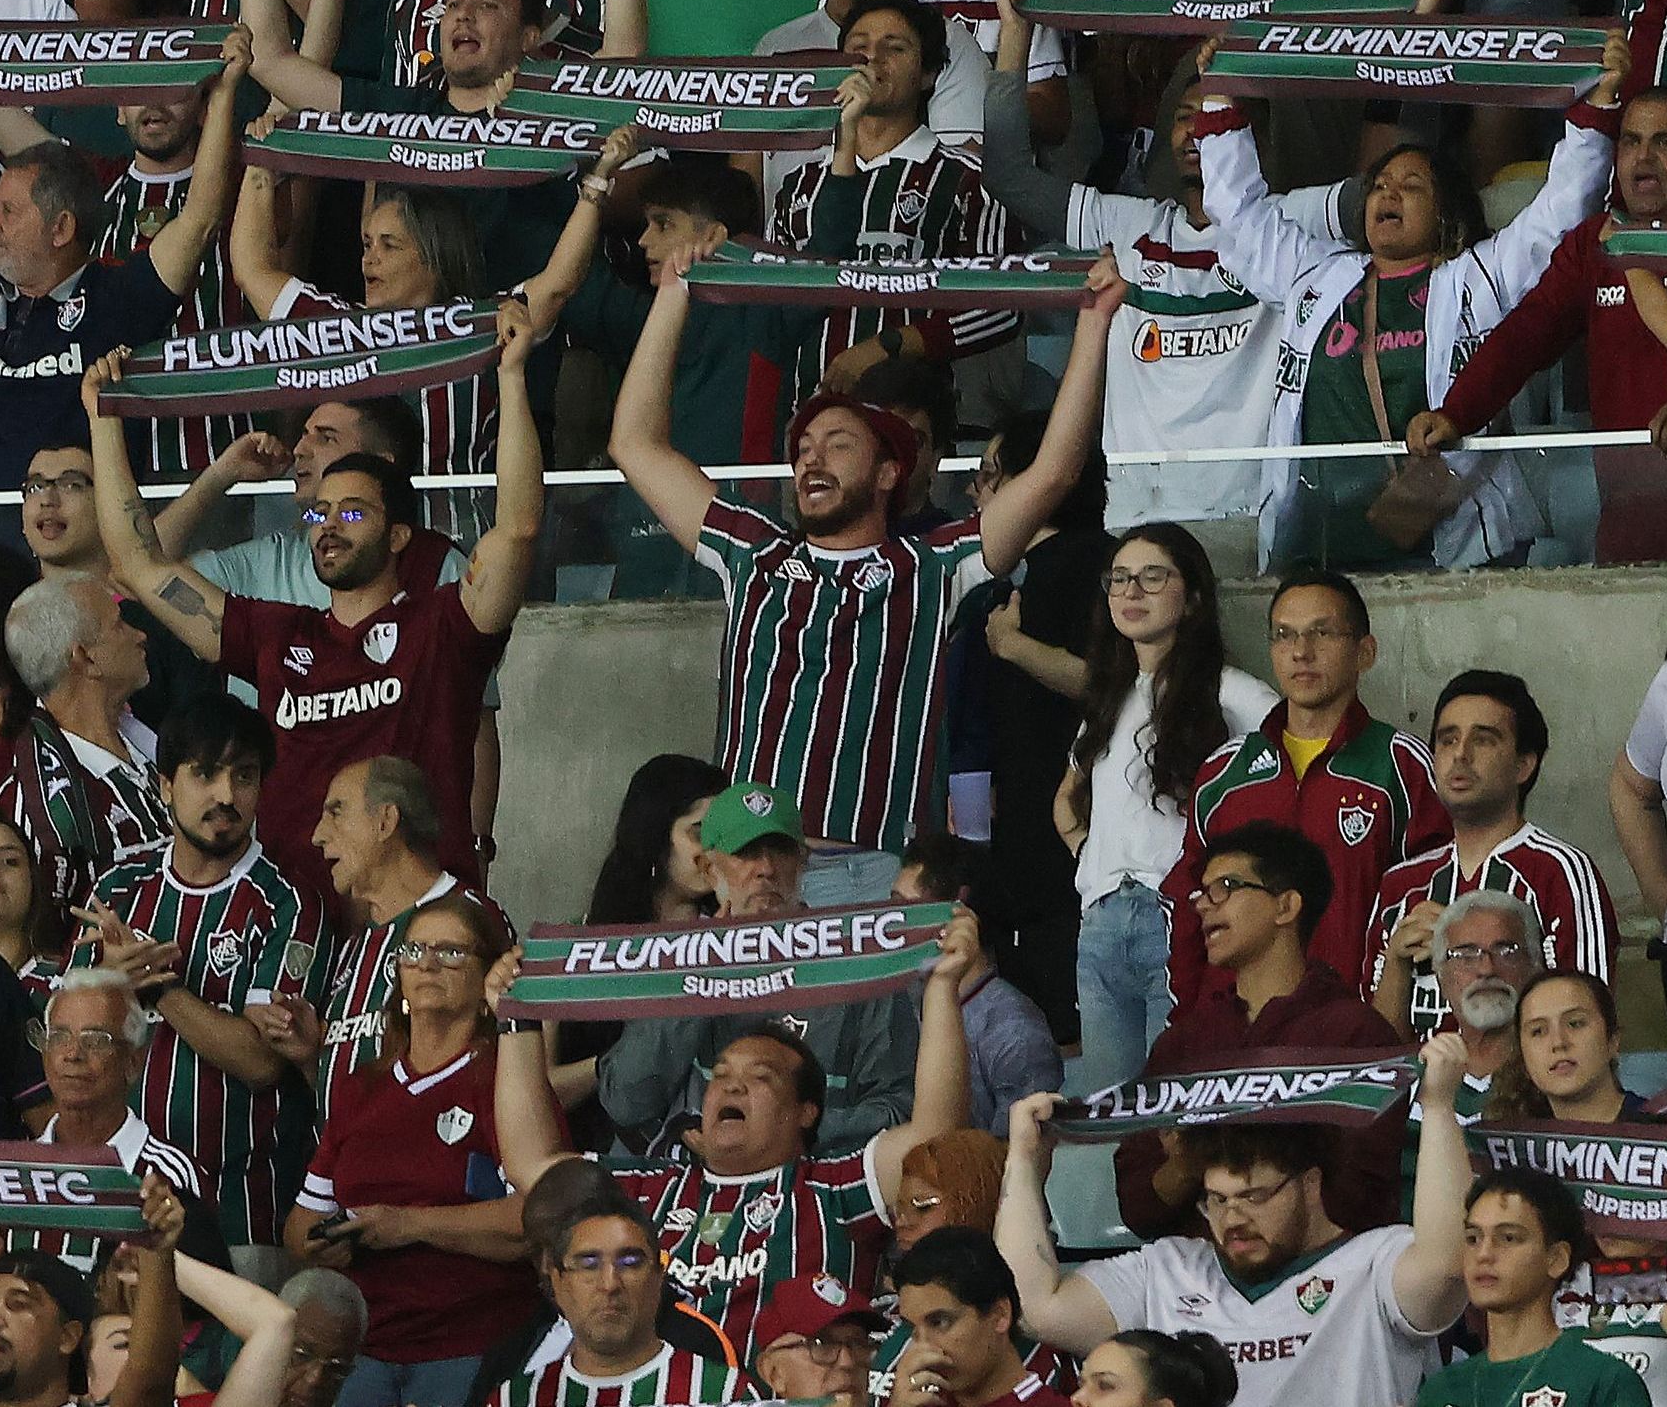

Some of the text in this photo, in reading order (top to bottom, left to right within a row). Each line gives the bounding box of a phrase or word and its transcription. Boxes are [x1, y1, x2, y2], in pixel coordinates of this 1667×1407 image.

[140, 31, 194, 60] FC
[1259, 27, 1564, 59] FLUMINENSE FC
[552, 67, 815, 106] FLUMINENSE FC
[1356, 64, 1455, 86] SUPERBET
[298, 113, 597, 146] FLUMINENSE FC
[636, 107, 723, 131] SUPERBET
[388, 144, 486, 169] SUPERBET
[837, 270, 940, 291] SUPERBET
[1596, 285, 1624, 300] 1902
[163, 303, 474, 371] FLUMINENSE FC
[278, 356, 380, 389] SUPERBET
[298, 677, 402, 723] BETANO
[564, 912, 905, 973] FLUMINENSE FC
[683, 968, 795, 997] SUPERBET
[32, 1172, 96, 1203] FC
